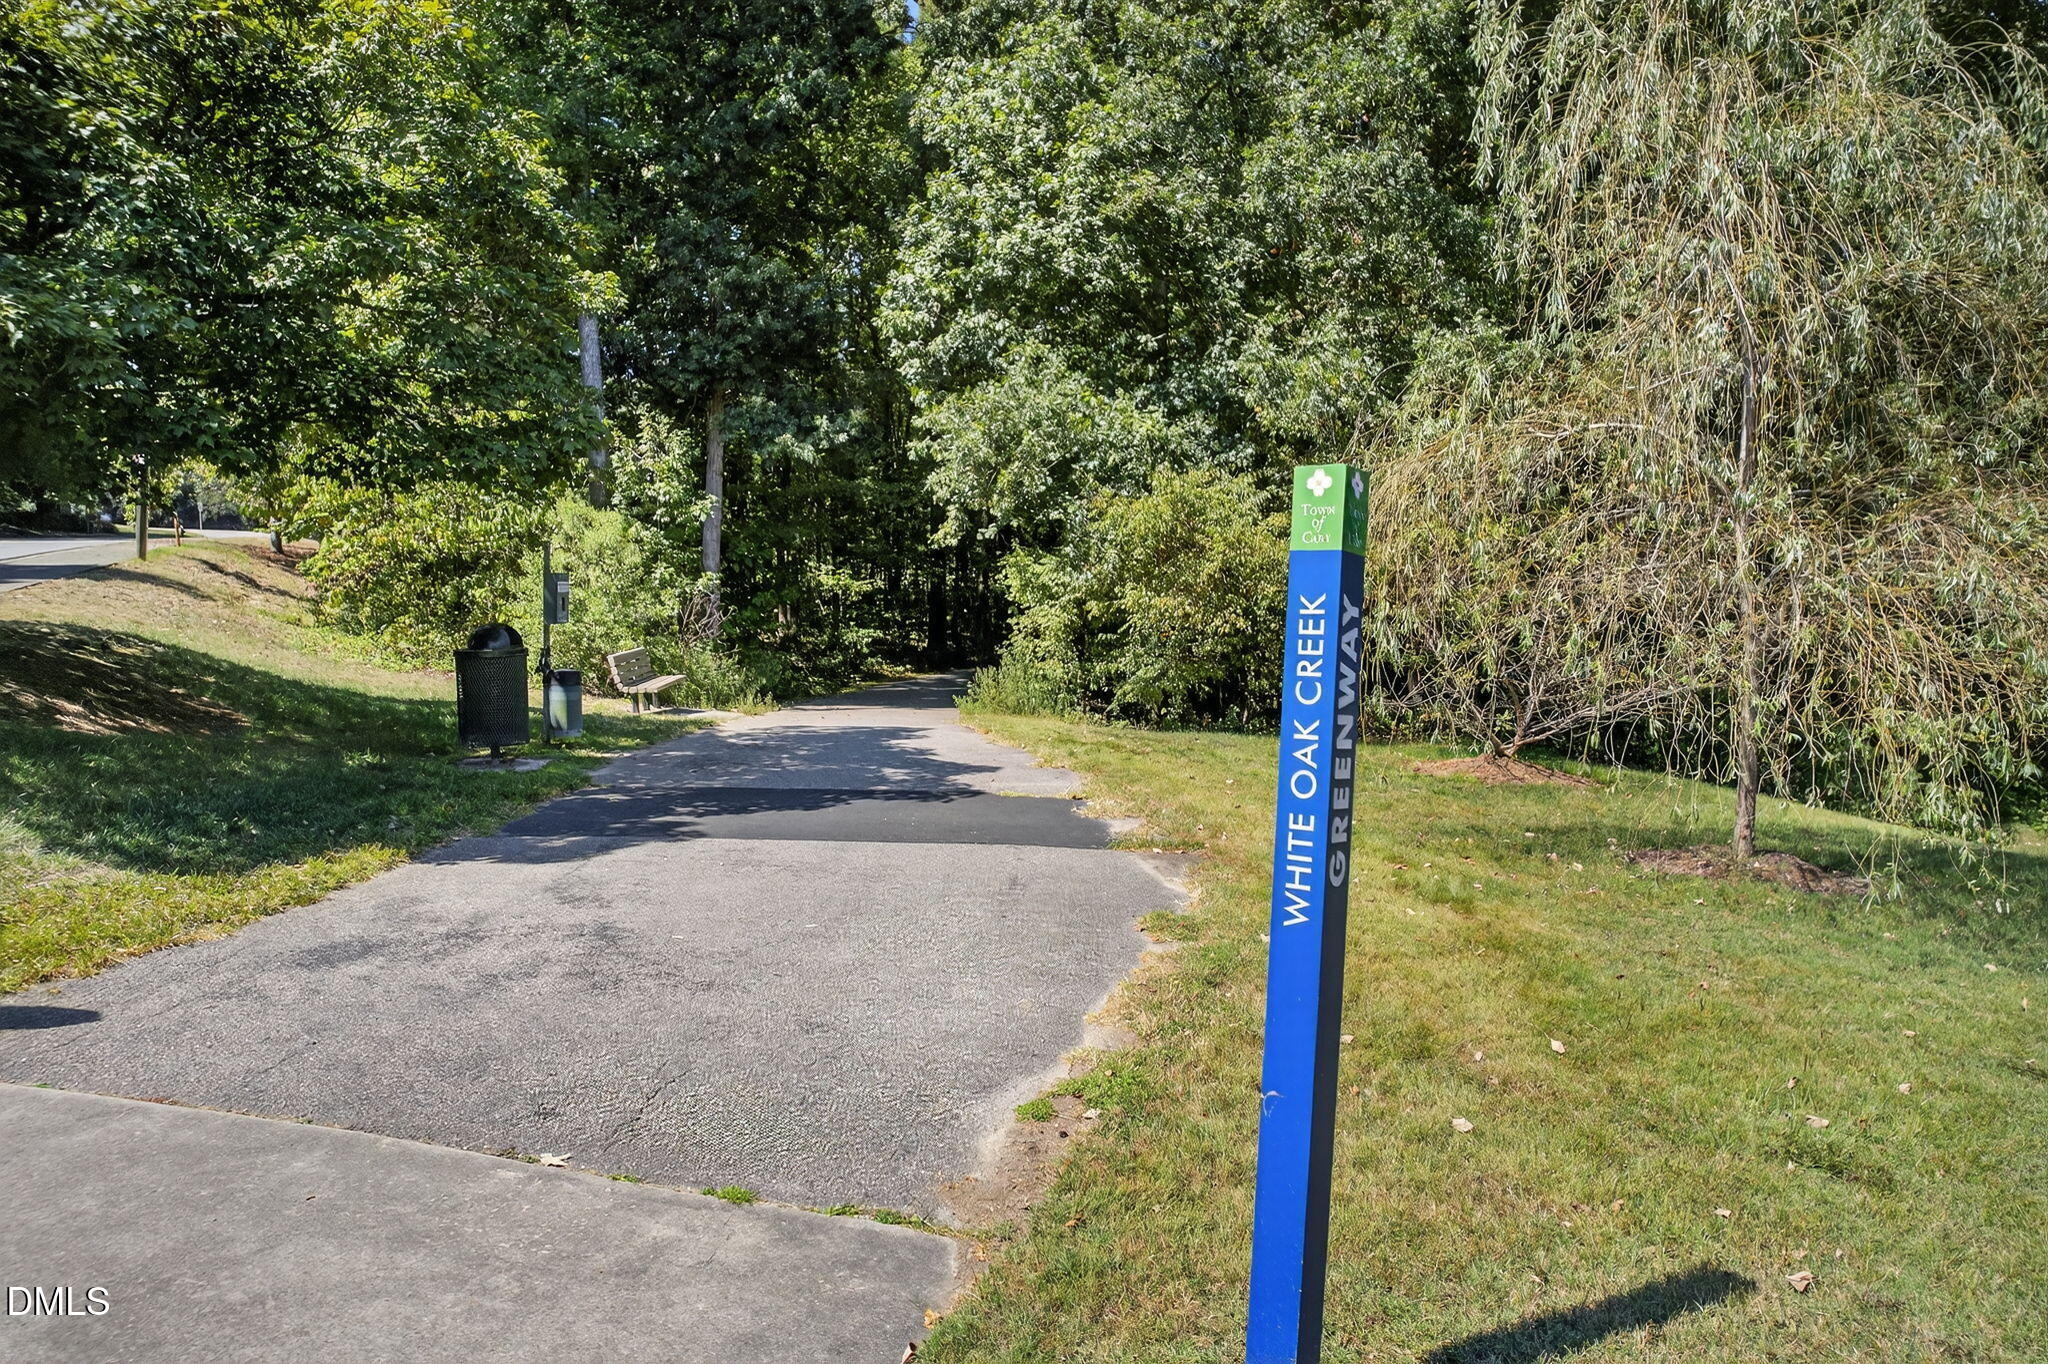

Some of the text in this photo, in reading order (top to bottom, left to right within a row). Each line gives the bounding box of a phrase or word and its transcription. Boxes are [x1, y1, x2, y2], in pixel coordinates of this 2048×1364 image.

[1300, 503, 1336, 516] Town
[1311, 515, 1327, 533] of
[1283, 593, 1327, 926] WHITE OAK CREEK
[1329, 592, 1361, 888] GREENWAY
